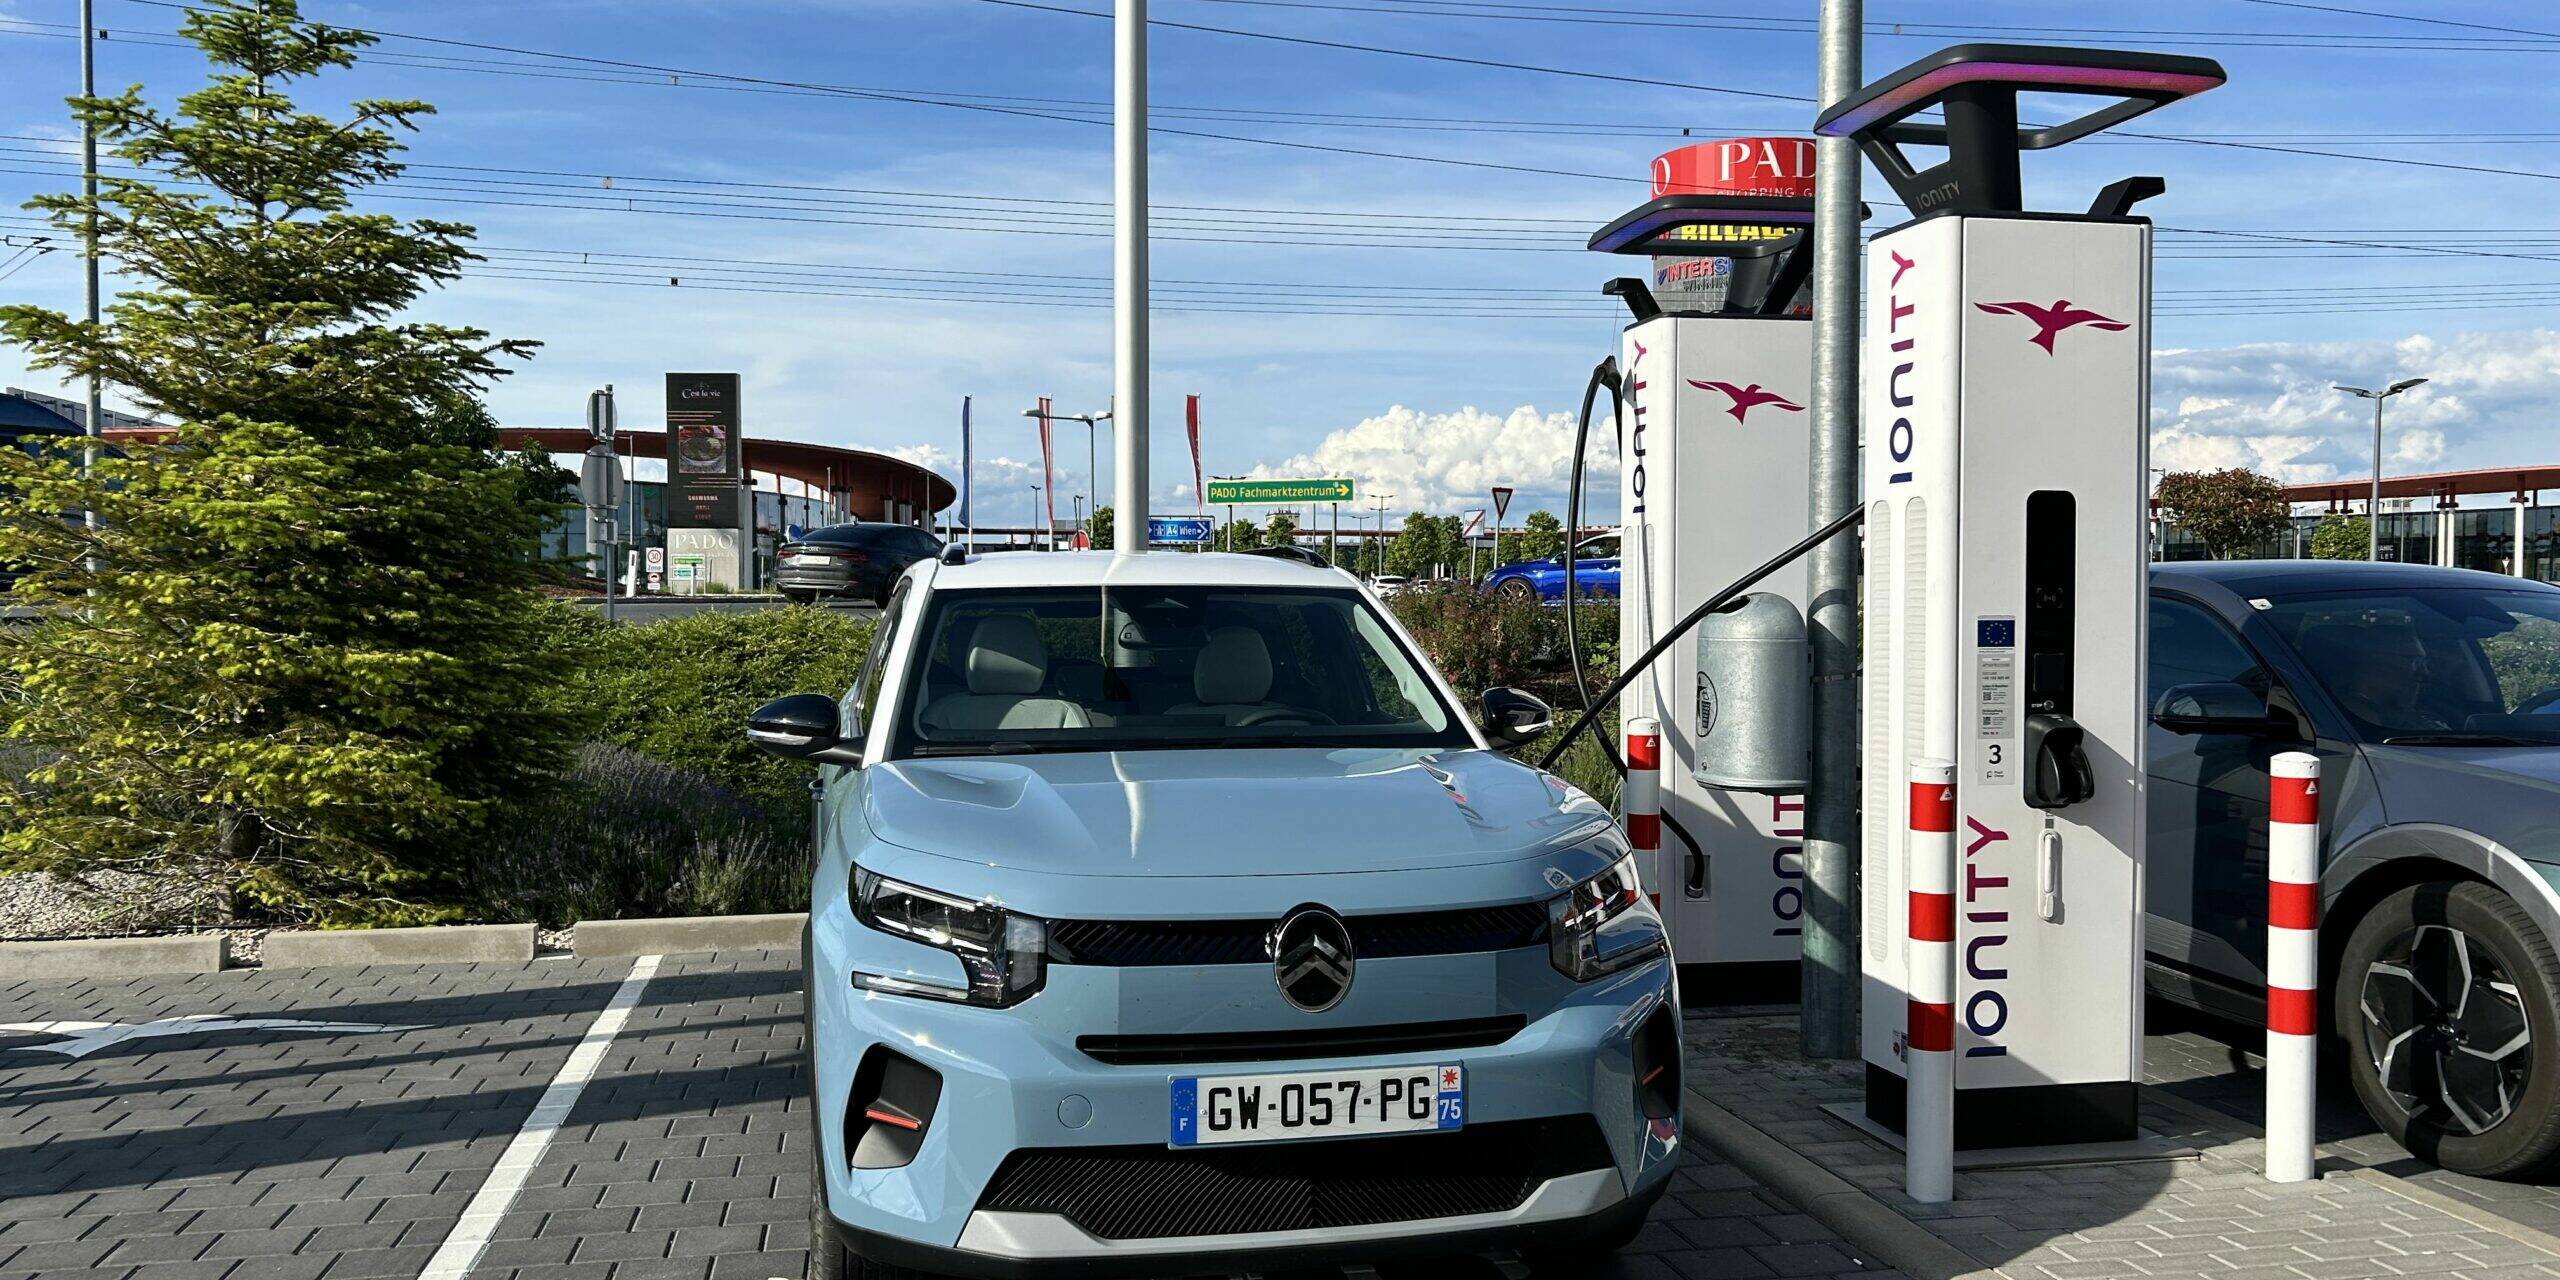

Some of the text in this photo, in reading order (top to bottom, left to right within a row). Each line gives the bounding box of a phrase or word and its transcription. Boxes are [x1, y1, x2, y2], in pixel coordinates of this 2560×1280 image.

[1719, 140, 1815, 182] PAD
[1668, 257, 1732, 282] INTERS
[1889, 249, 1915, 484] IONITY
[1632, 339, 1647, 513] IONITY
[1210, 485, 1335, 498] PADO Fachmarktzentrum
[675, 534, 733, 550] PADO
[1166, 525, 1197, 535] A4 Wien
[650, 552, 659, 560] 30
[1988, 744, 2002, 765] 3
[1772, 794, 1804, 937] IONIT
[1965, 814, 2009, 1058] IONITY
[1179, 1076, 1461, 1131] F GW-057-PG 75
